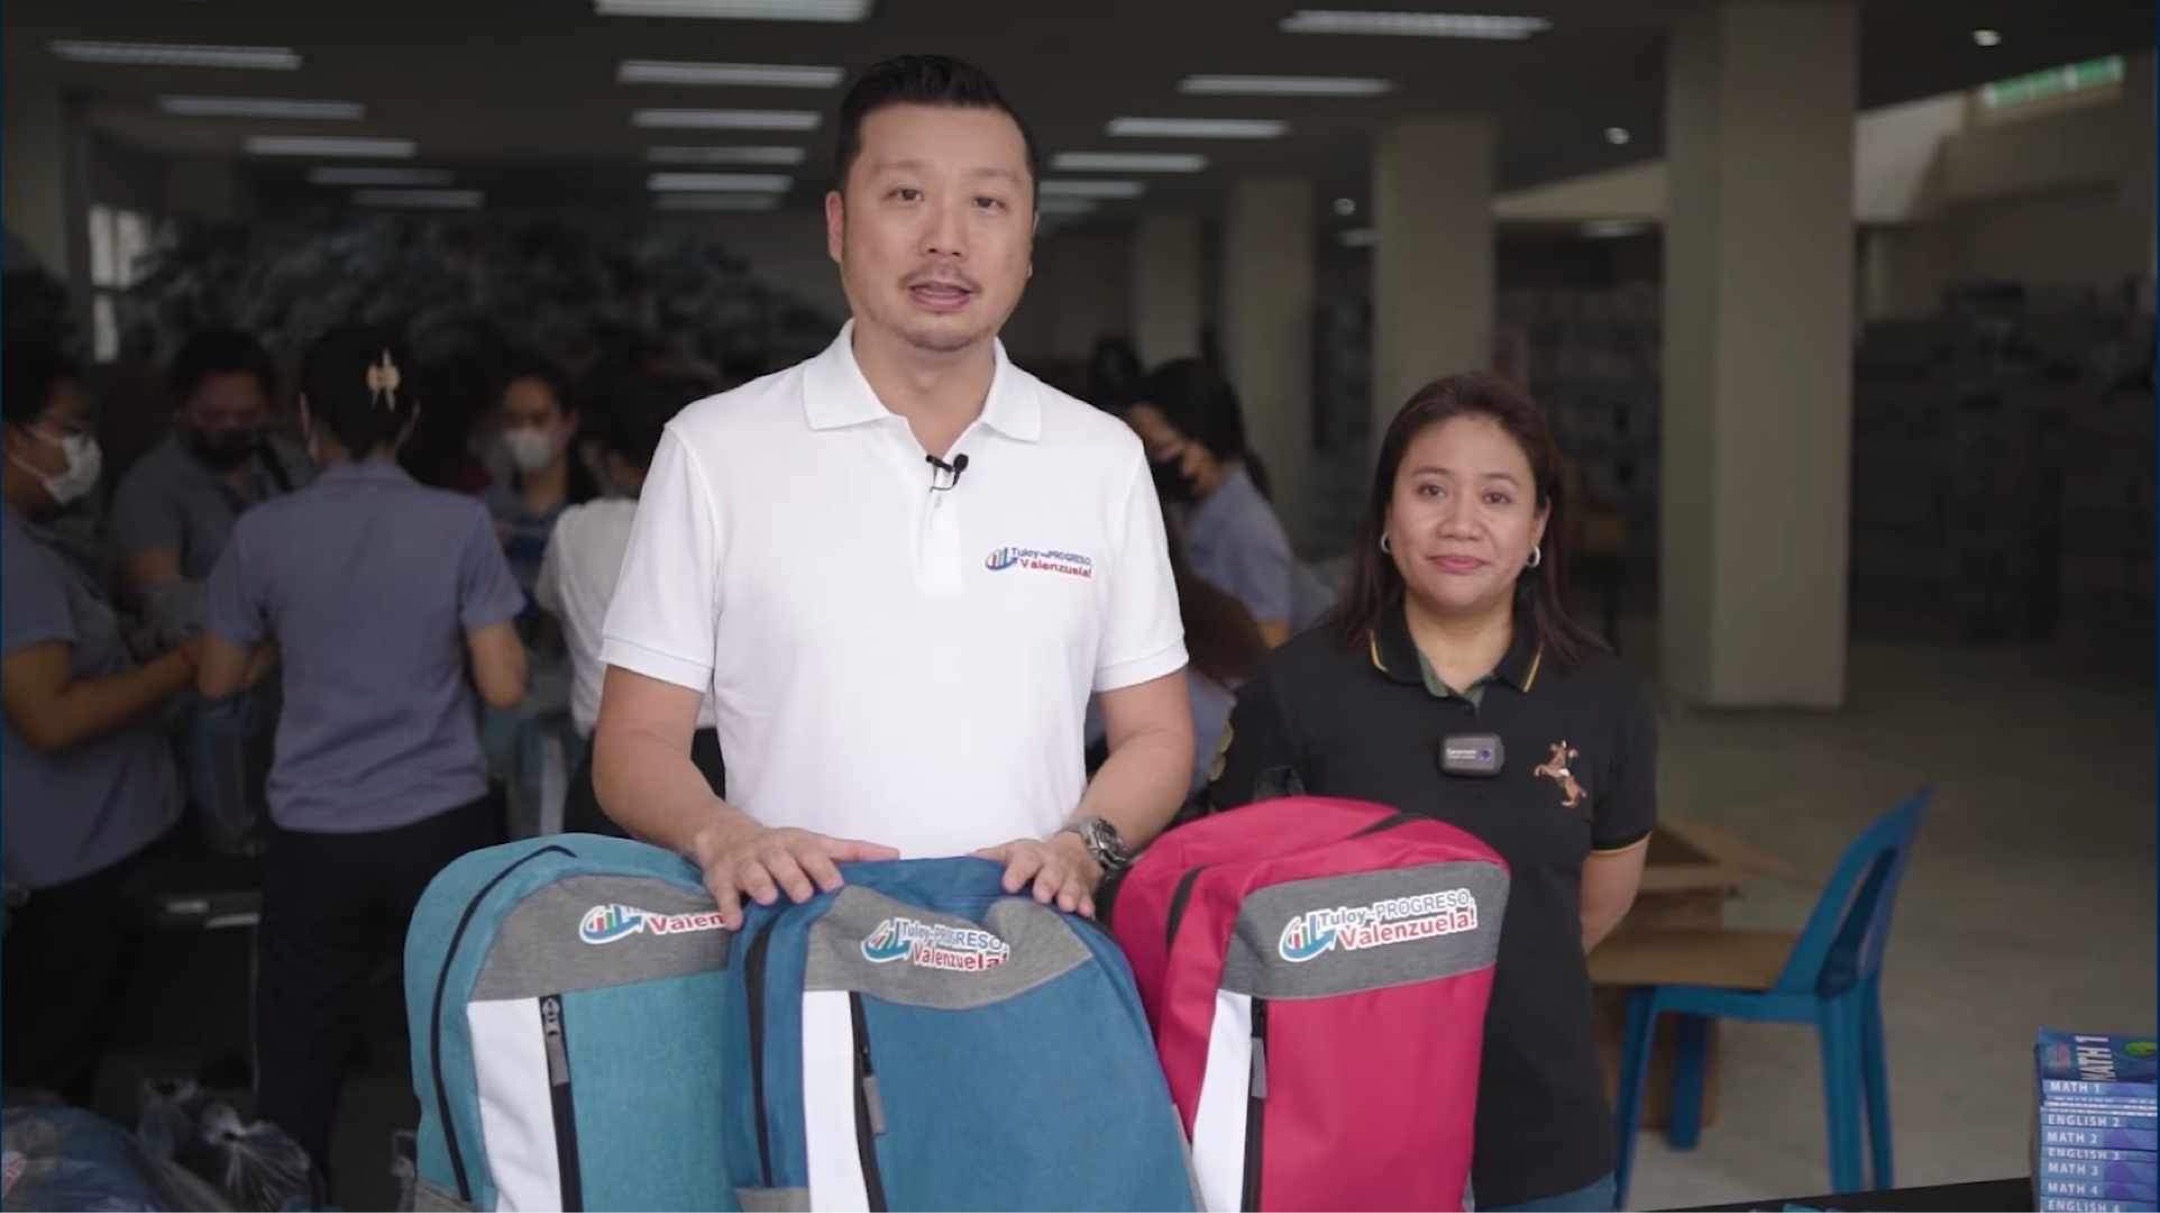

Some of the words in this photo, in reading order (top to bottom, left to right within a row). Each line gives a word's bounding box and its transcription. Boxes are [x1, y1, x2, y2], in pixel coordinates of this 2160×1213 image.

[650, 913, 725, 933] Valen
[1319, 909, 1366, 927] Tuloy
[1340, 908, 1476, 948] Valenzuela!
[2049, 1080, 2088, 1093] MATH
[2094, 1082, 2100, 1093] 1
[2047, 1113, 2107, 1126] ENGLISH
[2112, 1116, 2120, 1127] 2
[2047, 1131, 2085, 1143] MATH
[2090, 1134, 2098, 1144] 2
[2047, 1147, 2107, 1160] ENGLISH
[2047, 1162, 2086, 1175] MATH
[2091, 1165, 2099, 1177] 3
[2047, 1182, 2086, 1194] MATH
[2090, 1185, 2098, 1195] 4
[2047, 1199, 2106, 1212] ENGLISH
